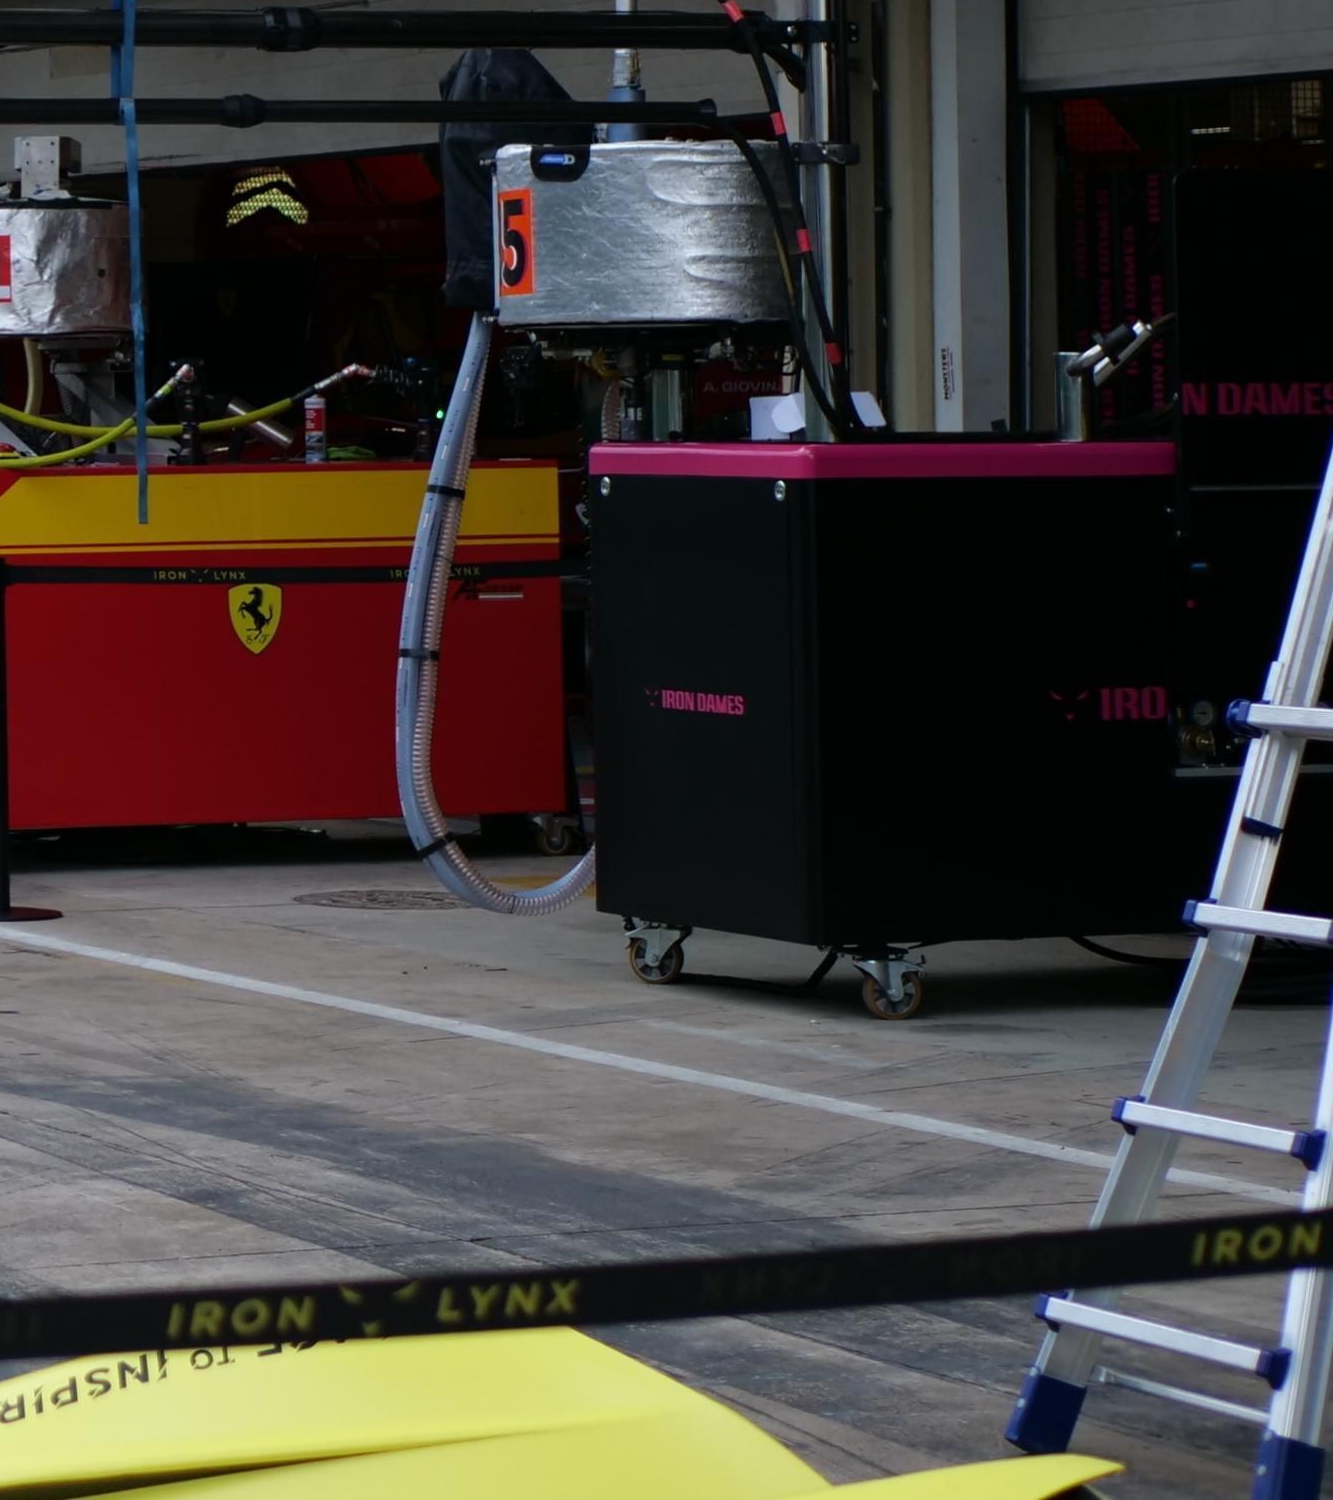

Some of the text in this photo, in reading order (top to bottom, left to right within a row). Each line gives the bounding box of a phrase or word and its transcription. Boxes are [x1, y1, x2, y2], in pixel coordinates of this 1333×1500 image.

[153, 570, 247, 582] IRON LYNX
[661, 689, 745, 716] IRON DAMES
[1190, 1220, 1325, 1268] IRON
[166, 1278, 583, 1341] IRON LYNX
[191, 1346, 237, 1371] TO
